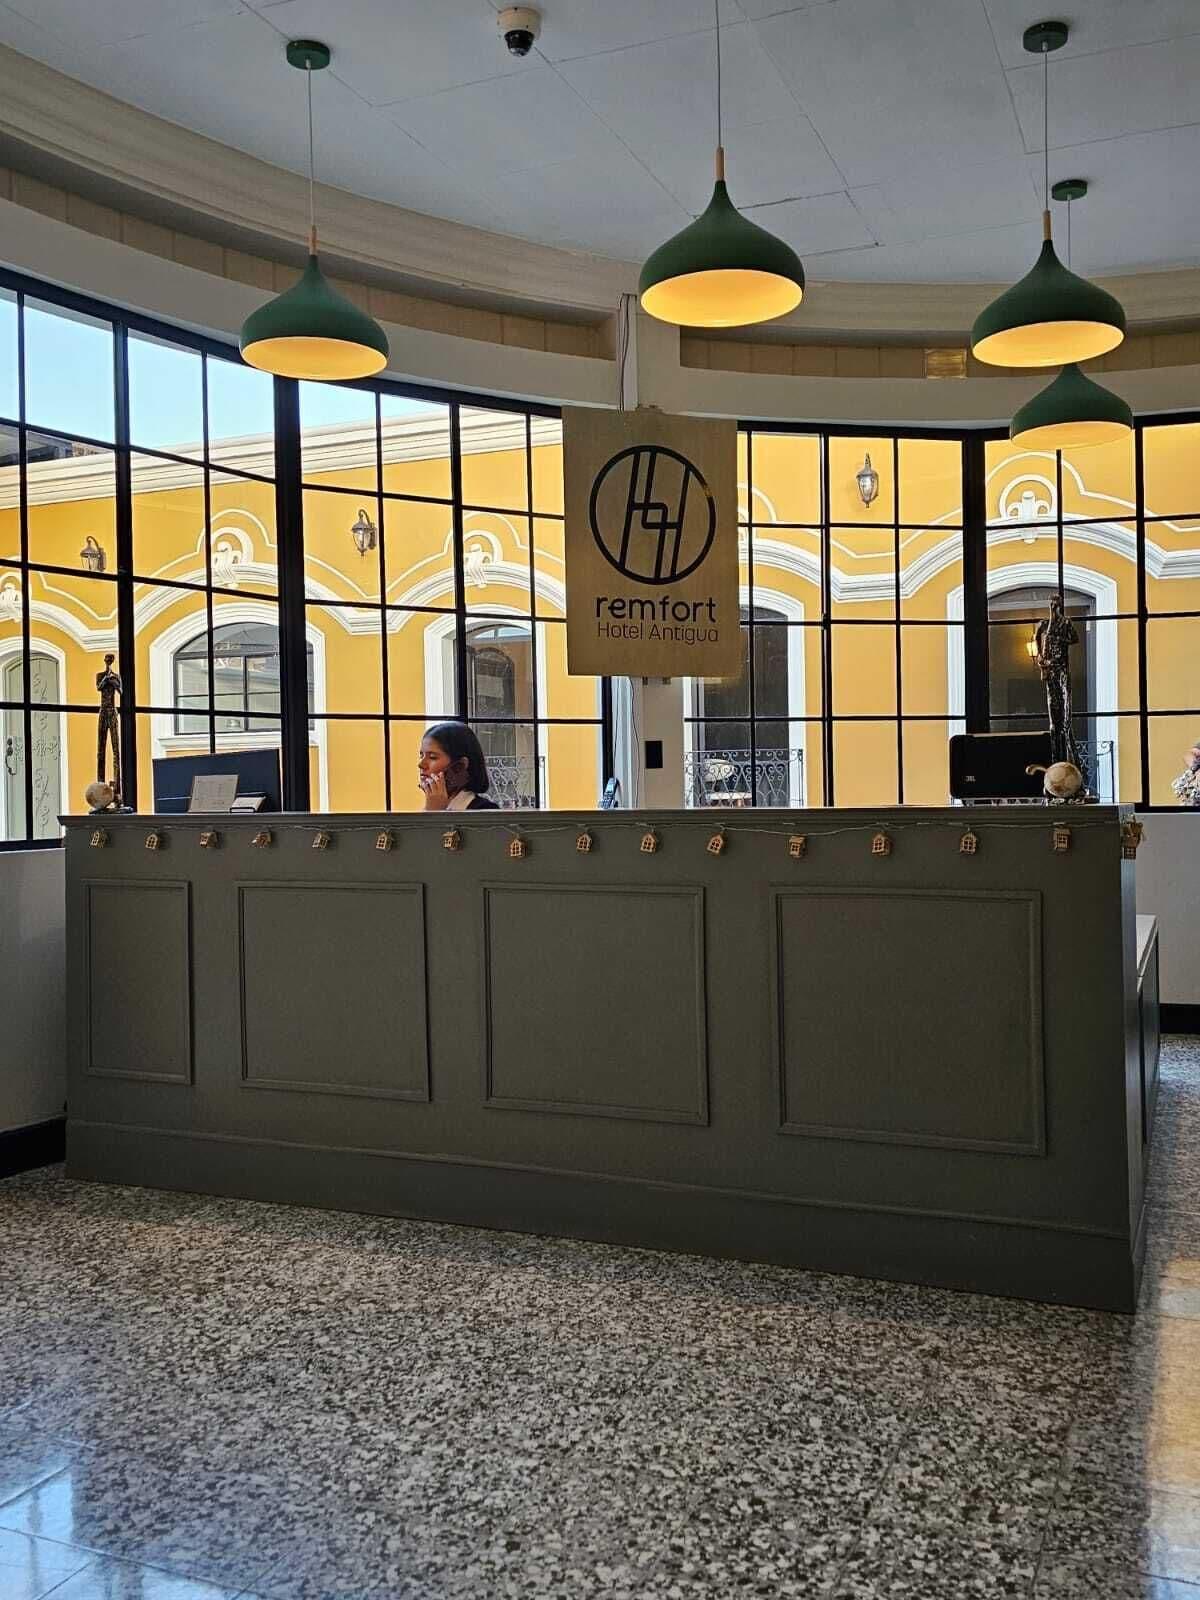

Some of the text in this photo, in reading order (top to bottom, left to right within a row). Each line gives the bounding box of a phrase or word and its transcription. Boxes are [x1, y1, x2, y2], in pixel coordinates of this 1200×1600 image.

[596, 595, 716, 623] remfort
[598, 622, 719, 646] Hotel Antigua
